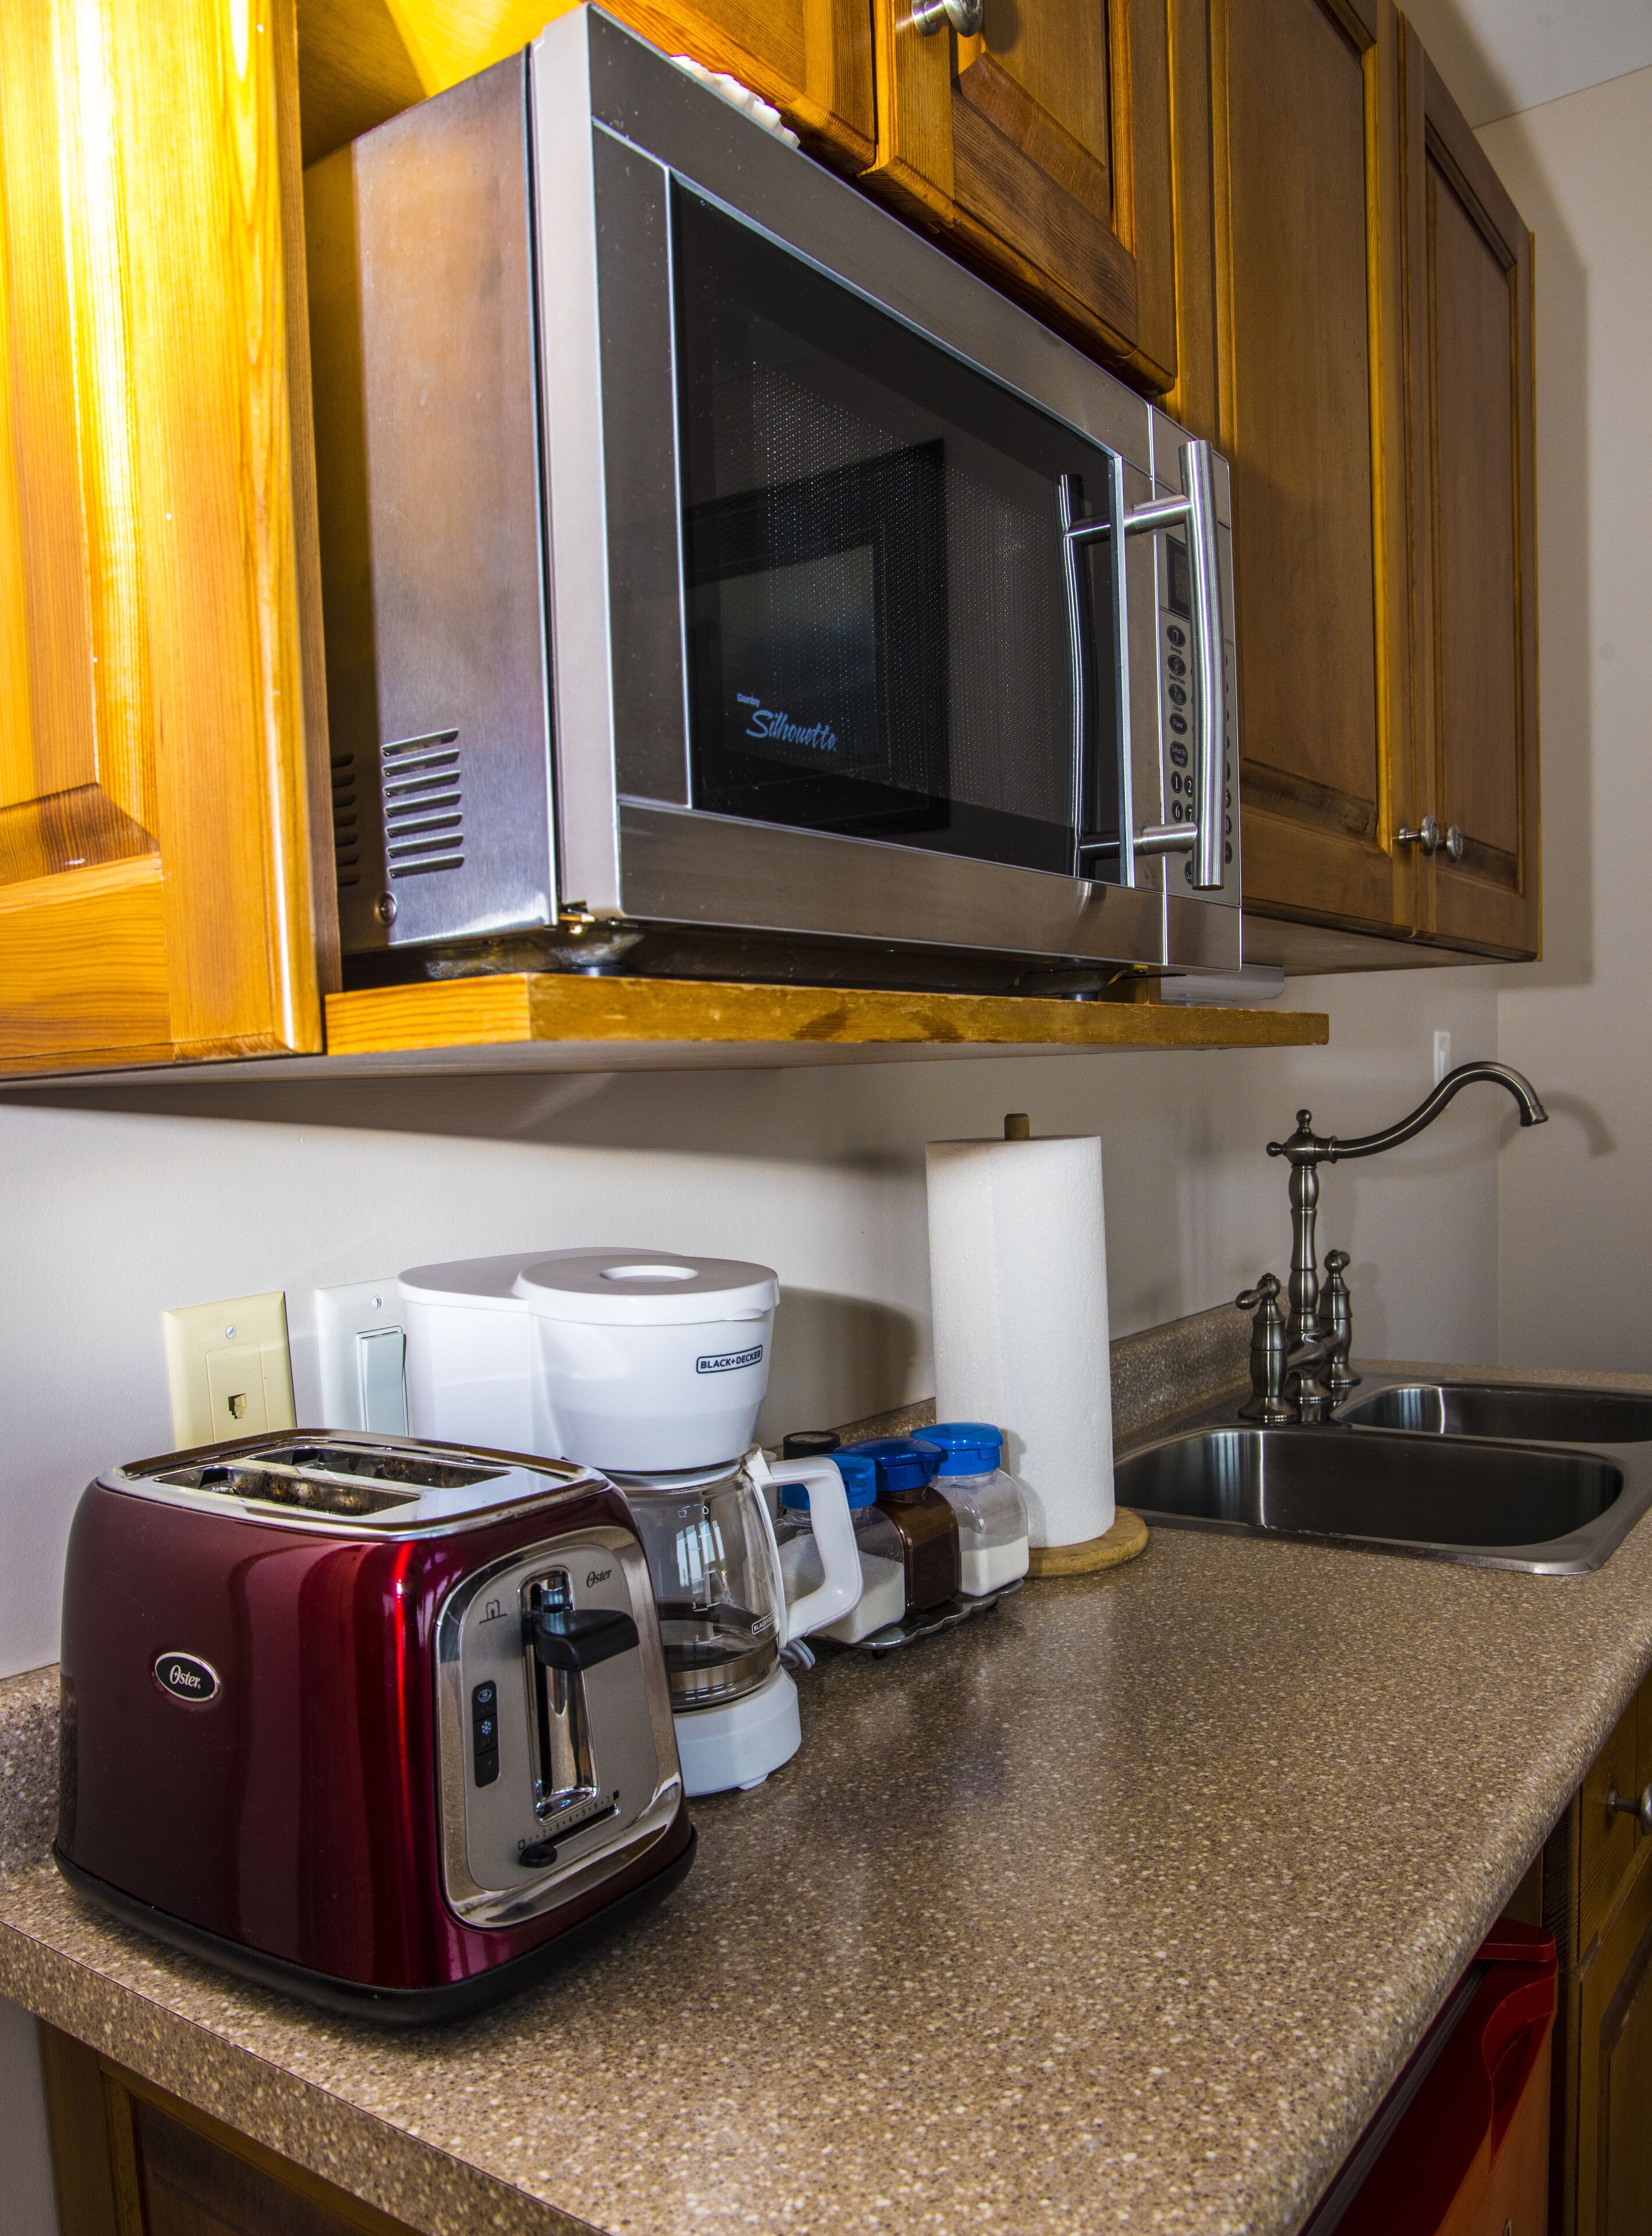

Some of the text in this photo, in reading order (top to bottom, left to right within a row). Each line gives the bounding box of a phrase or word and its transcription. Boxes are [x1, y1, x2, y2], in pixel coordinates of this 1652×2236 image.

[745, 709, 838, 751] Silhouette
[1173, 719, 1184, 729] Power
[1175, 777, 1192, 792] 1 2
[1175, 805, 1180, 818] 6
[1188, 808, 1193, 821] 7
[701, 1350, 760, 1369] BLACK+DECKER
[586, 1570, 612, 1588] Oster
[169, 1665, 200, 1688] Oster
[542, 1829, 546, 1837] 2
